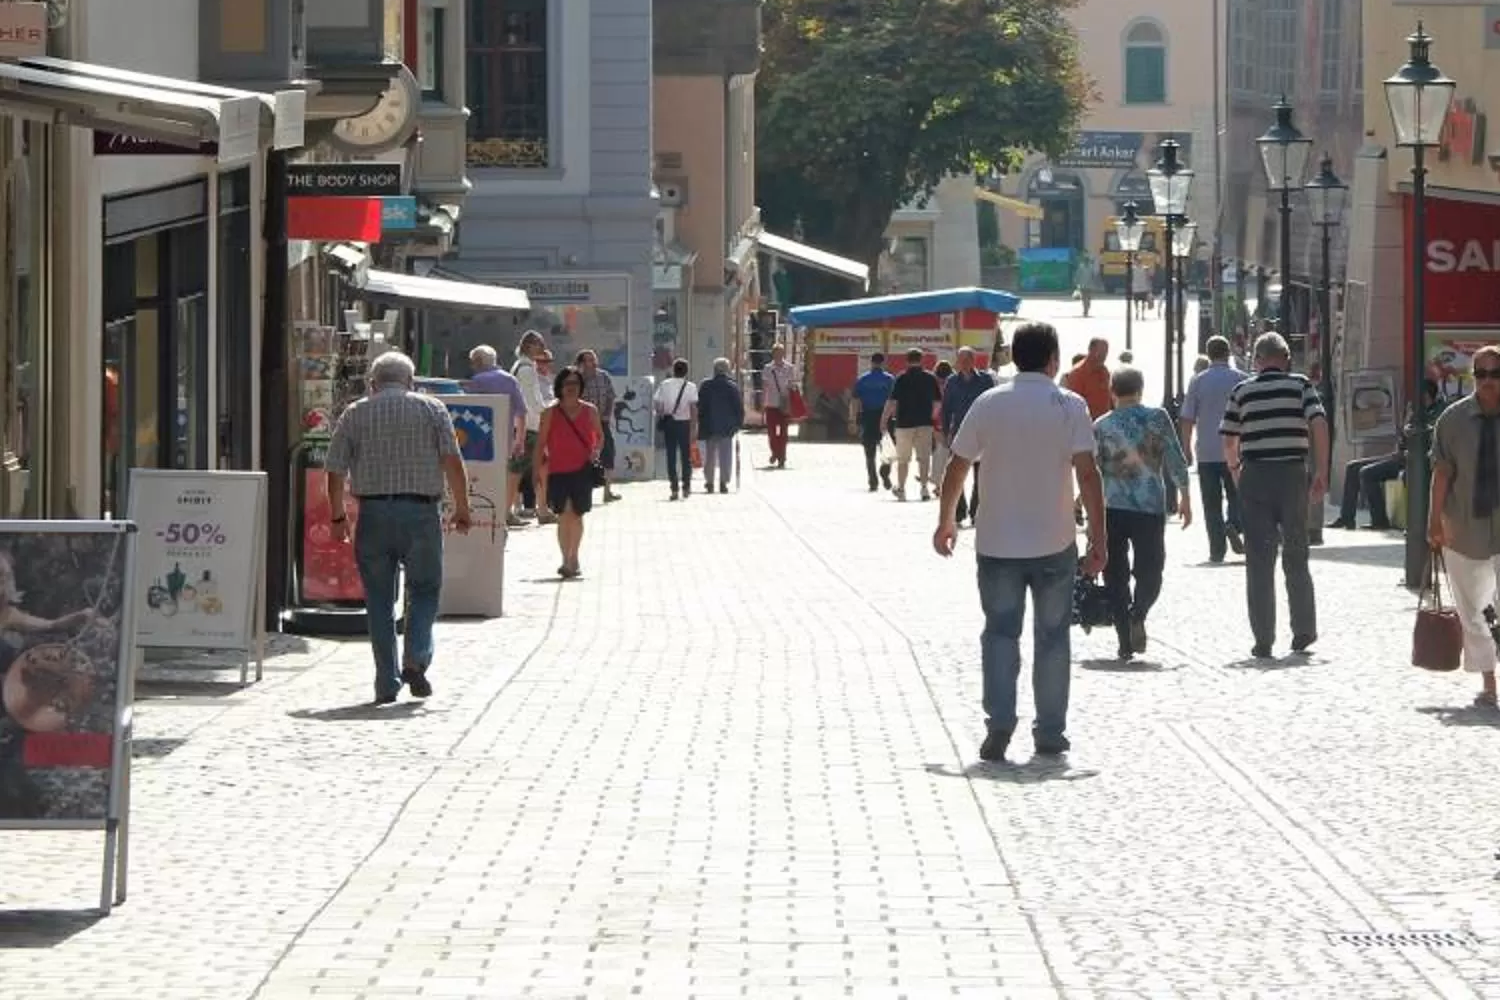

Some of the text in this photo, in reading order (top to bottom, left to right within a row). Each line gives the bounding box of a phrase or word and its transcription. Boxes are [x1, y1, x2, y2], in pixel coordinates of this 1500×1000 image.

[287, 173, 397, 187] THE BODY SHOP
[156, 522, 226, 545] -50%
